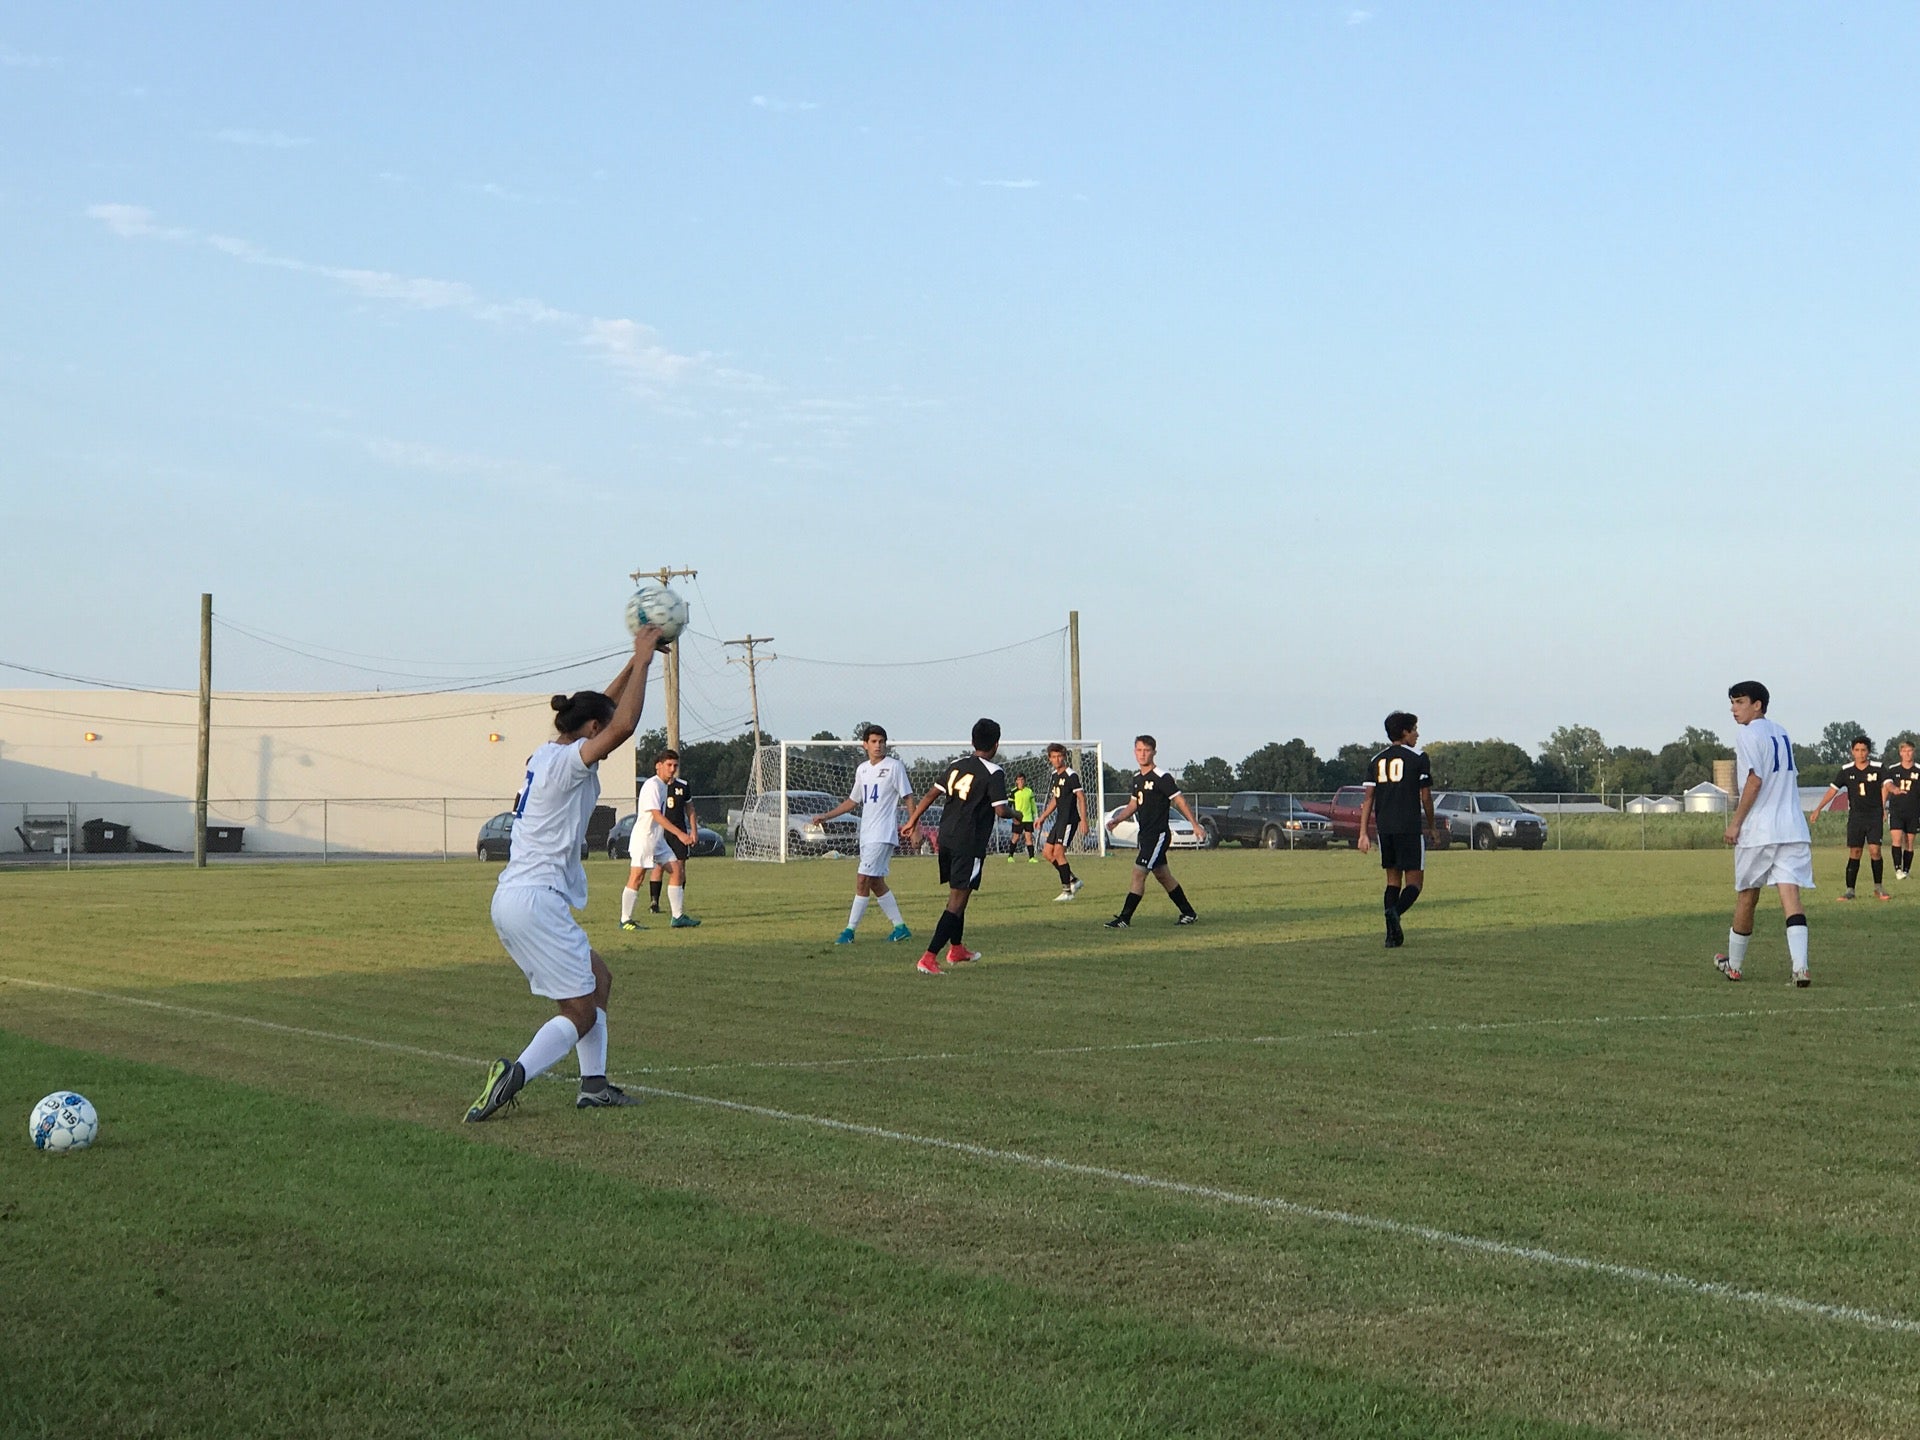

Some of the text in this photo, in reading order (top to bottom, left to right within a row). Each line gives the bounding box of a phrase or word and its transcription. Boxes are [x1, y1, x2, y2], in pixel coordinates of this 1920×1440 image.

[1770, 734, 1794, 773] 11
[1377, 757, 1404, 784] 10
[1866, 772, 1878, 782] M
[863, 783, 879, 804] 14
[947, 768, 975, 801] 14
[1859, 782, 1866, 796] 1
[1900, 779, 1912, 791] 17
